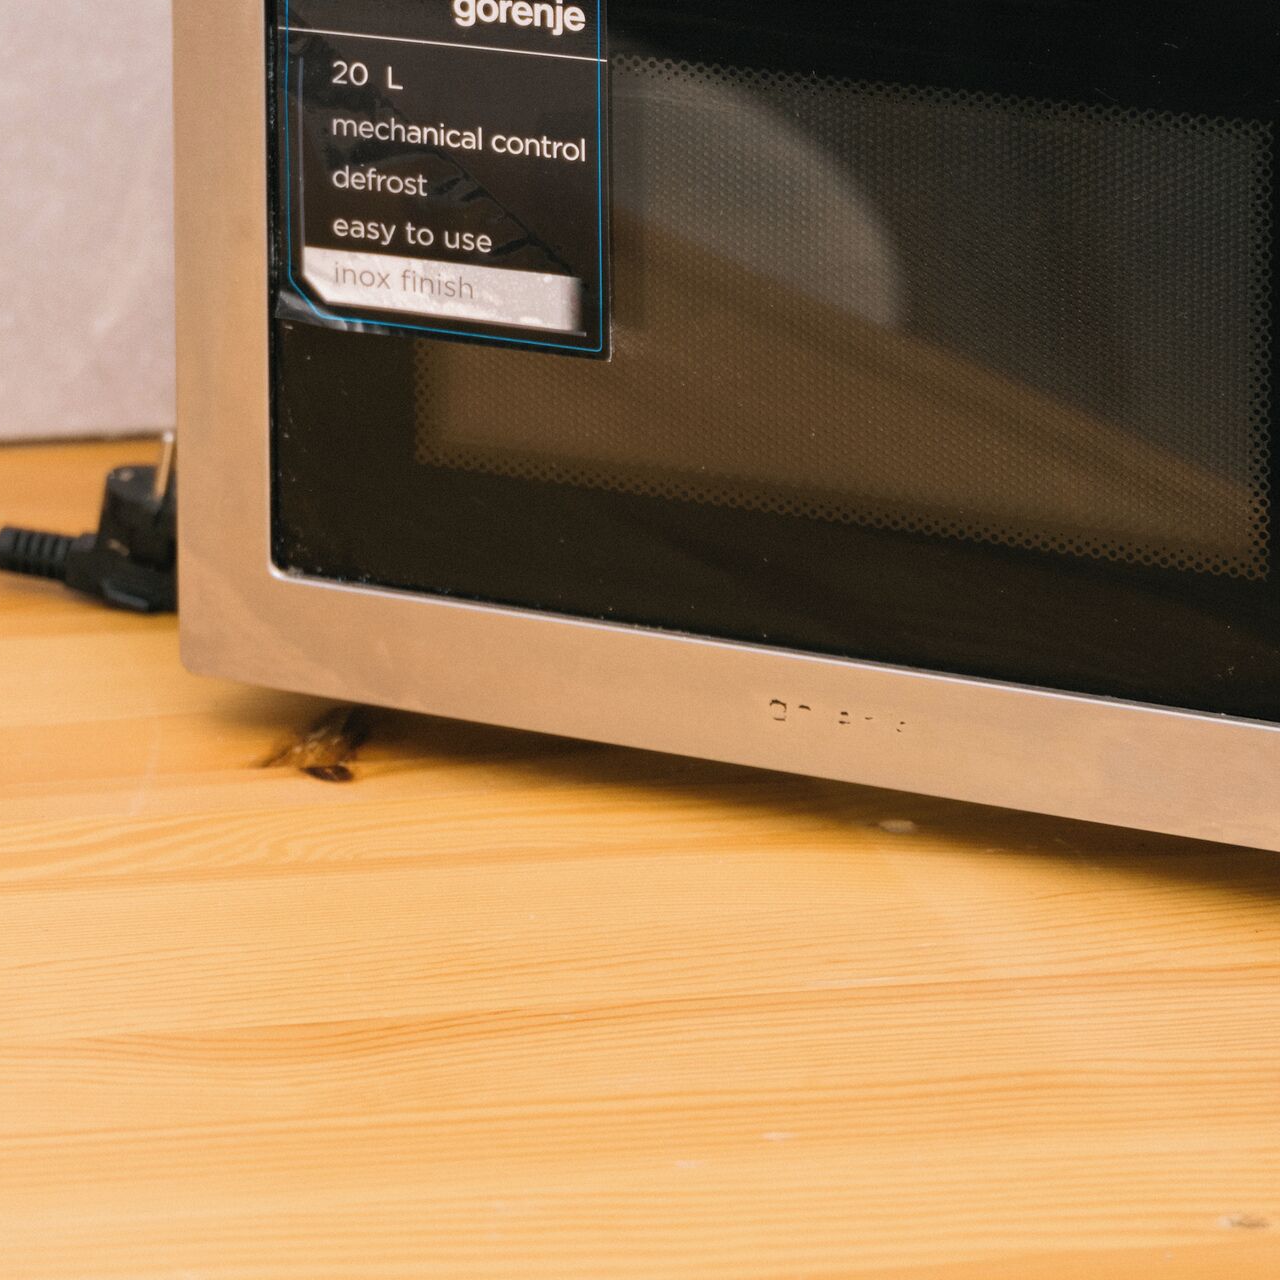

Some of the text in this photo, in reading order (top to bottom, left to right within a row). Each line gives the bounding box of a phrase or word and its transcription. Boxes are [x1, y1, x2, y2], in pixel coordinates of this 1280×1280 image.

[332, 61, 403, 90] 20 L
[332, 116, 586, 162] mechanical control
[332, 165, 428, 197] defrost
[333, 218, 492, 253] easy to use
[334, 261, 474, 300] inox finish
